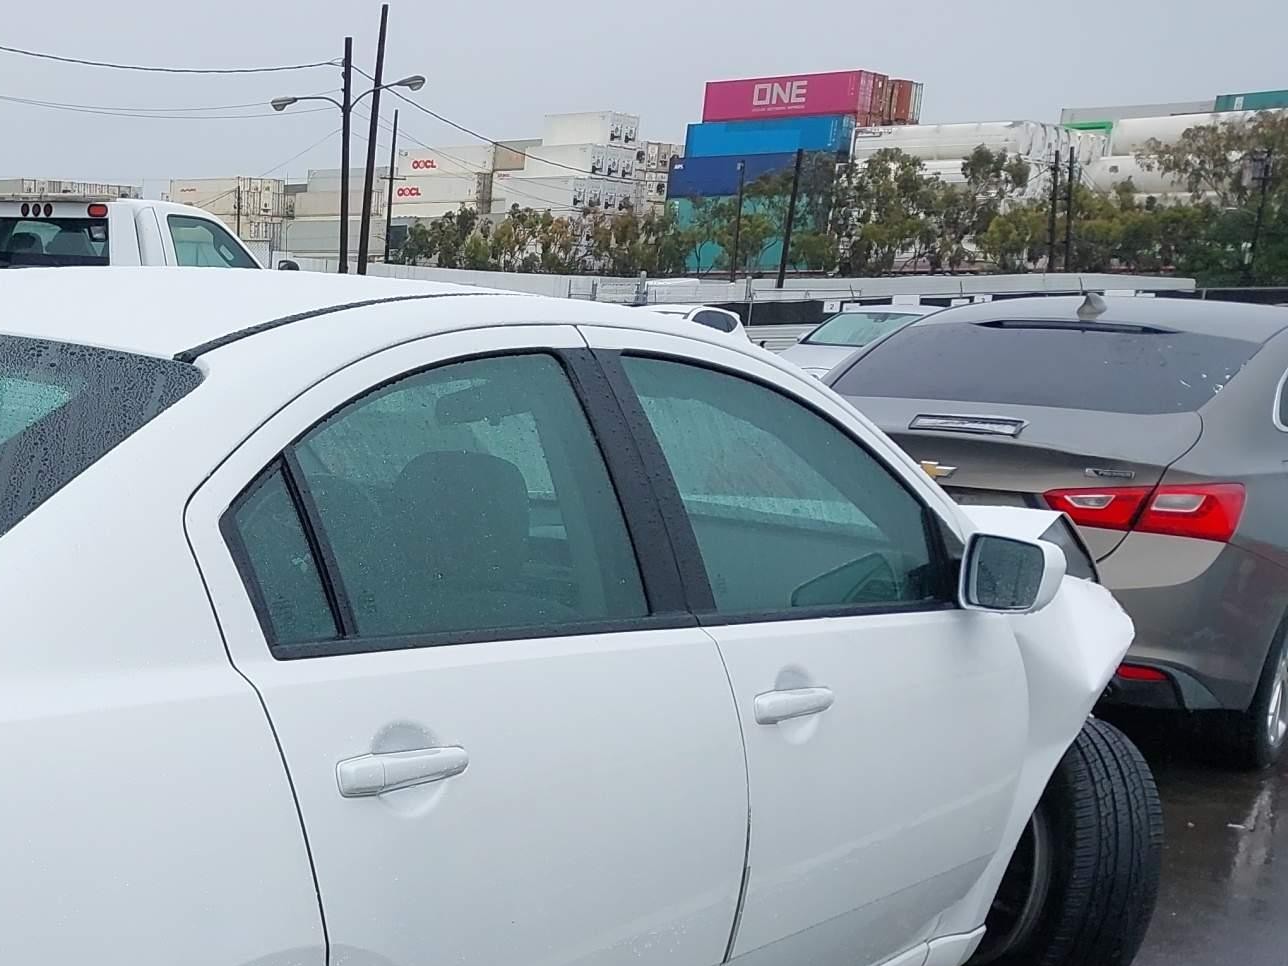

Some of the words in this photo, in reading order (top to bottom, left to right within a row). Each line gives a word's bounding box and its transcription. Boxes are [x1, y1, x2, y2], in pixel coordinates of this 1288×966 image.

[753, 81, 808, 105] ONE
[412, 160, 437, 170] OOCL
[397, 187, 422, 197] OOCL
